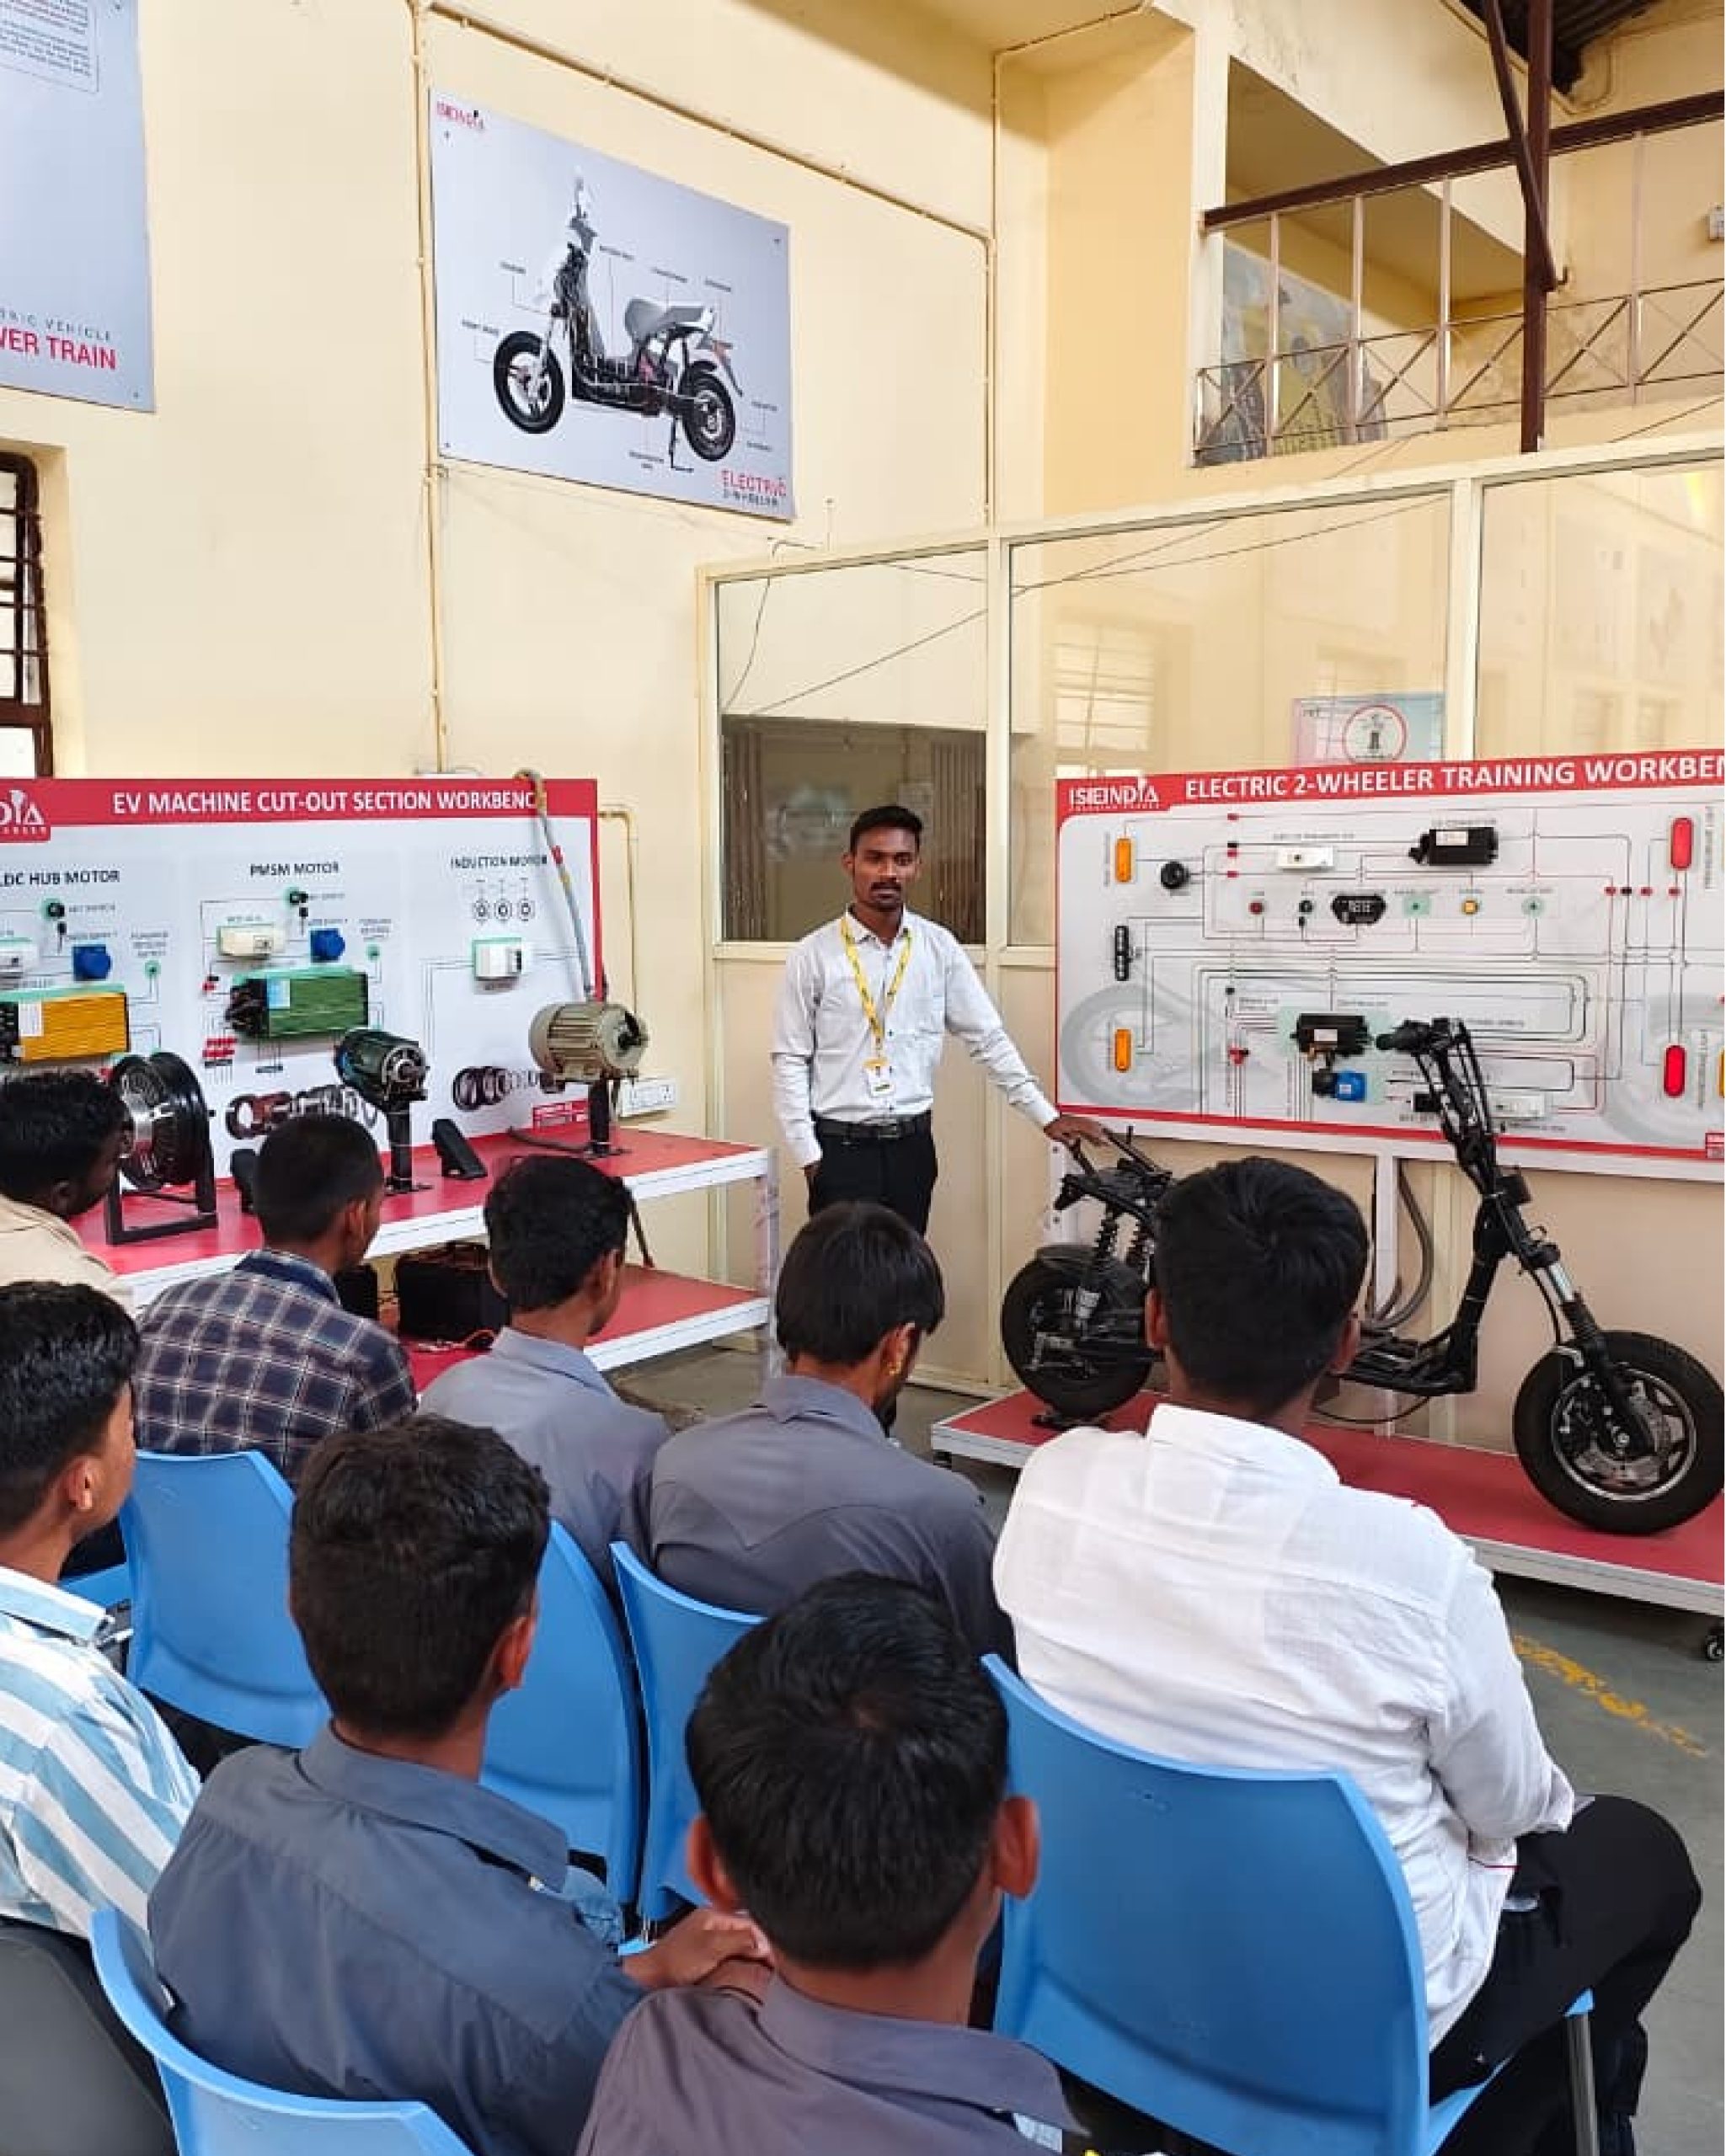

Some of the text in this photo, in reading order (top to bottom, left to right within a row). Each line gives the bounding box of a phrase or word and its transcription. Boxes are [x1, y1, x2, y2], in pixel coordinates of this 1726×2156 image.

[46, 335, 116, 371] TRAIN
[1185, 775, 1288, 799] ELECTRIC
[1293, 766, 1434, 794] 2-WHEELER
[1440, 761, 1575, 788] TRAINING
[112, 790, 537, 814] EV MACHINE CUT-OUT SECTION WORKBENC
[29, 871, 61, 885] HUB
[64, 869, 120, 883] MOTOR
[250, 861, 339, 877] PMSM MOTOR
